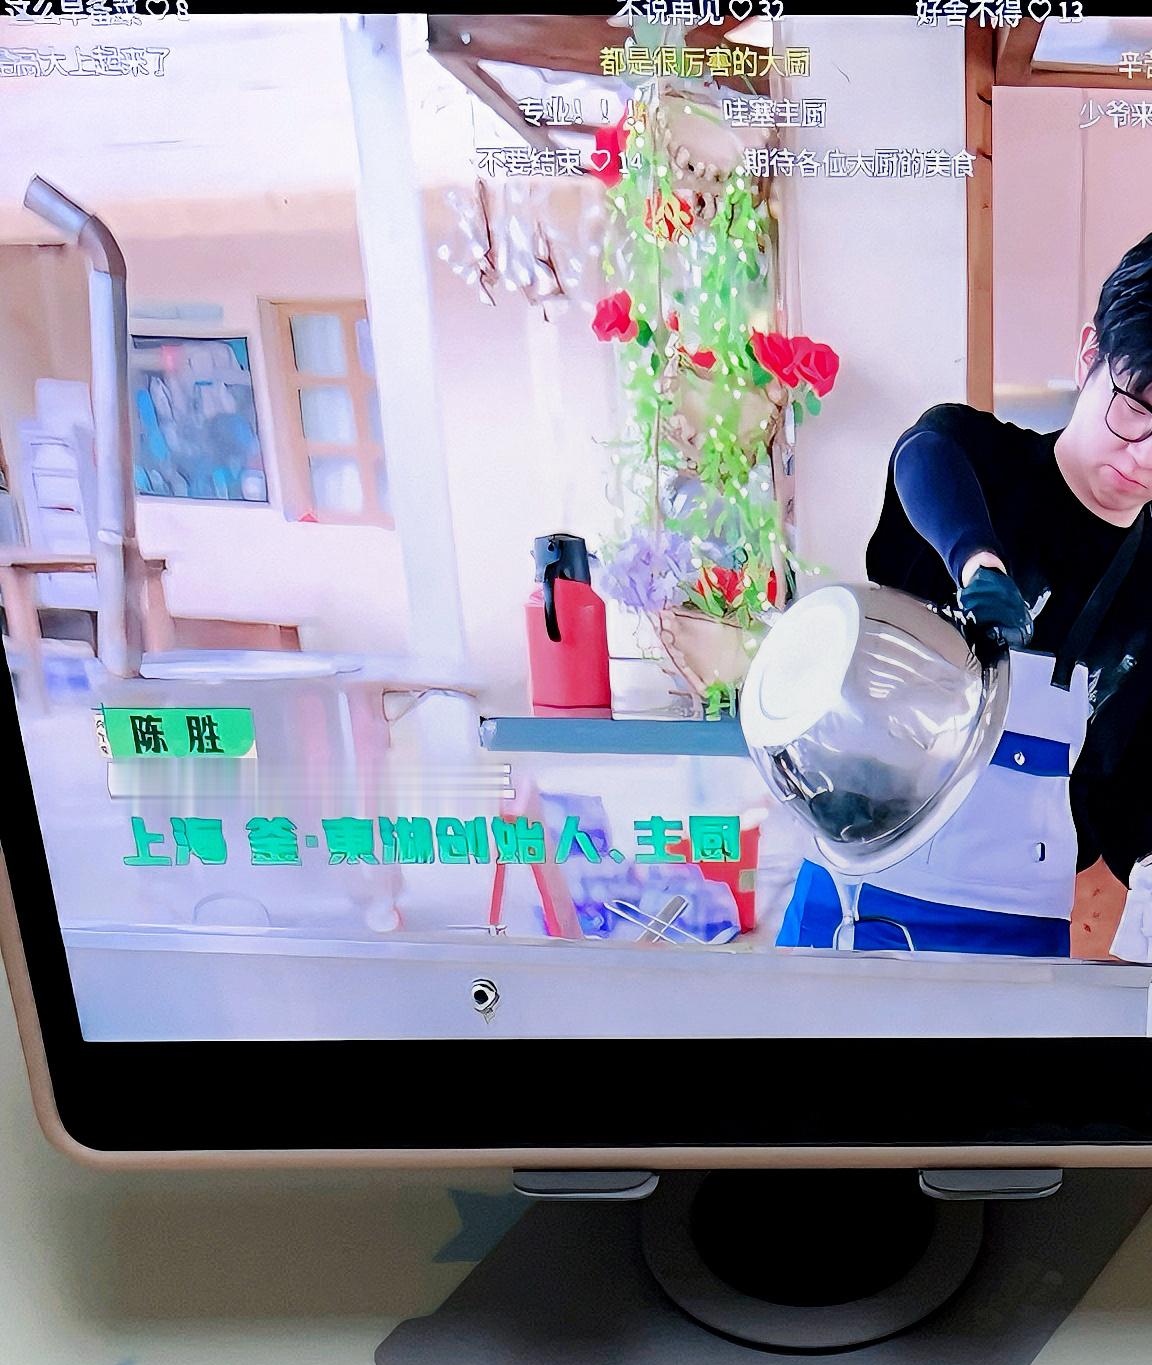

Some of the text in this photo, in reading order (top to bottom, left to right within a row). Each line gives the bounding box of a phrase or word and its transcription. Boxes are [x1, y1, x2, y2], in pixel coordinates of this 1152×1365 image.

[615, 0, 785, 26] 不说再见 32
[916, 0, 1083, 29] 好舍不得 13
[476, 147, 583, 177] 不要结束
